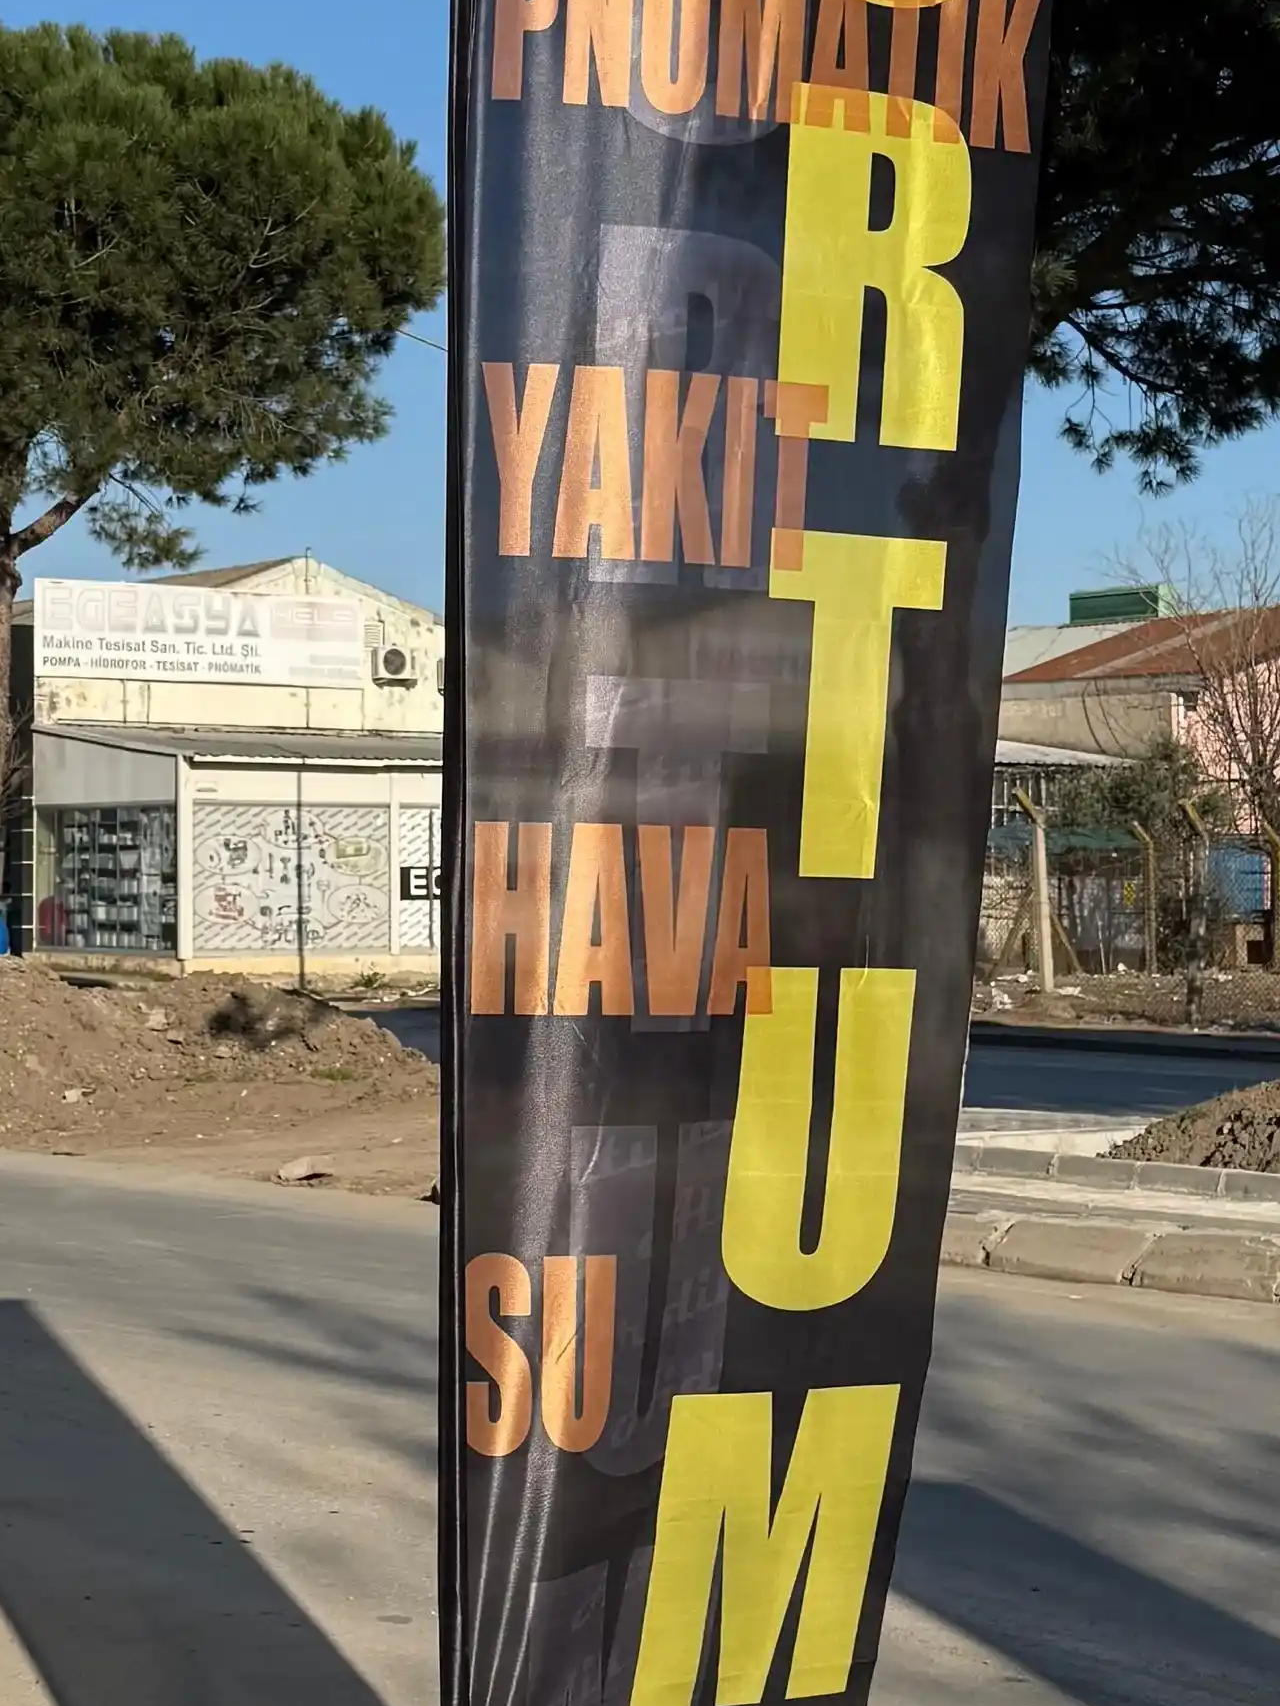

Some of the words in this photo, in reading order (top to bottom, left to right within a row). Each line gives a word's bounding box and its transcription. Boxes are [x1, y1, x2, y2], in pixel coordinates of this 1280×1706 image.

[481, 361, 829, 571] YAKIT
[42, 634, 93, 651] Makine
[97, 637, 146, 653] Tesisat
[150, 639, 180, 654] San.
[183, 641, 208, 656] Tic.
[42, 655, 81, 668] POMPA
[155, 657, 199, 672] TESİSAT
[470, 820, 773, 1015] HAVA
[464, 1252, 617, 1457] SU
